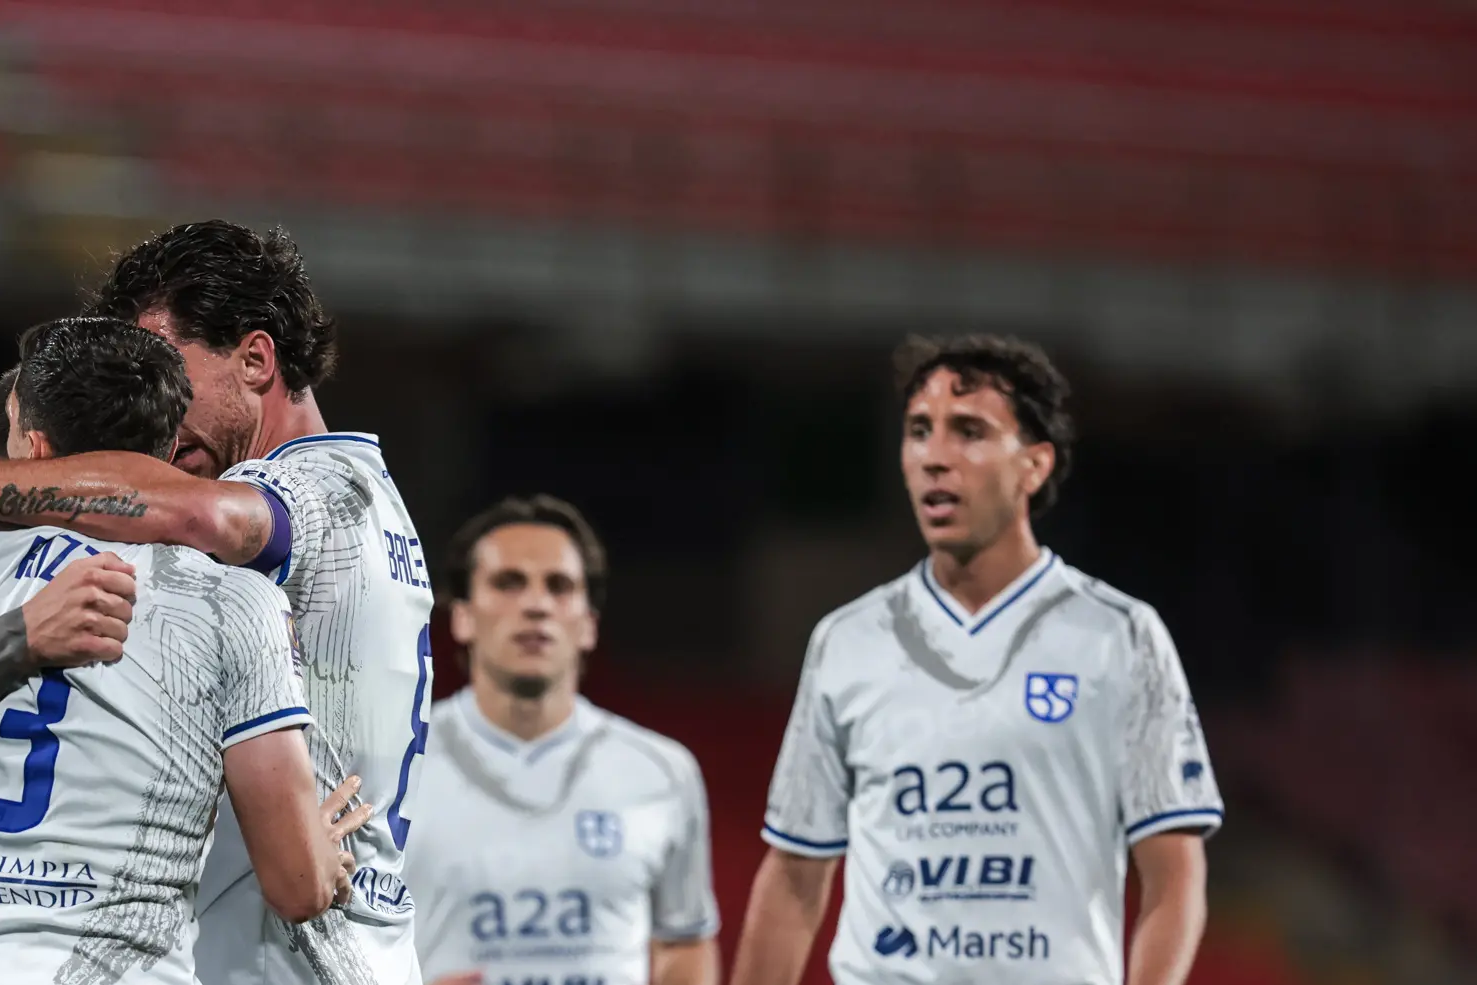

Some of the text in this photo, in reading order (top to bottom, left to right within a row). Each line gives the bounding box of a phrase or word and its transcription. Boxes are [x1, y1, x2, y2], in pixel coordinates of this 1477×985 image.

[893, 759, 1019, 816] a2a
[919, 854, 1036, 886] VIBI
[469, 887, 593, 942] a2a
[927, 924, 1050, 959] Marsh
